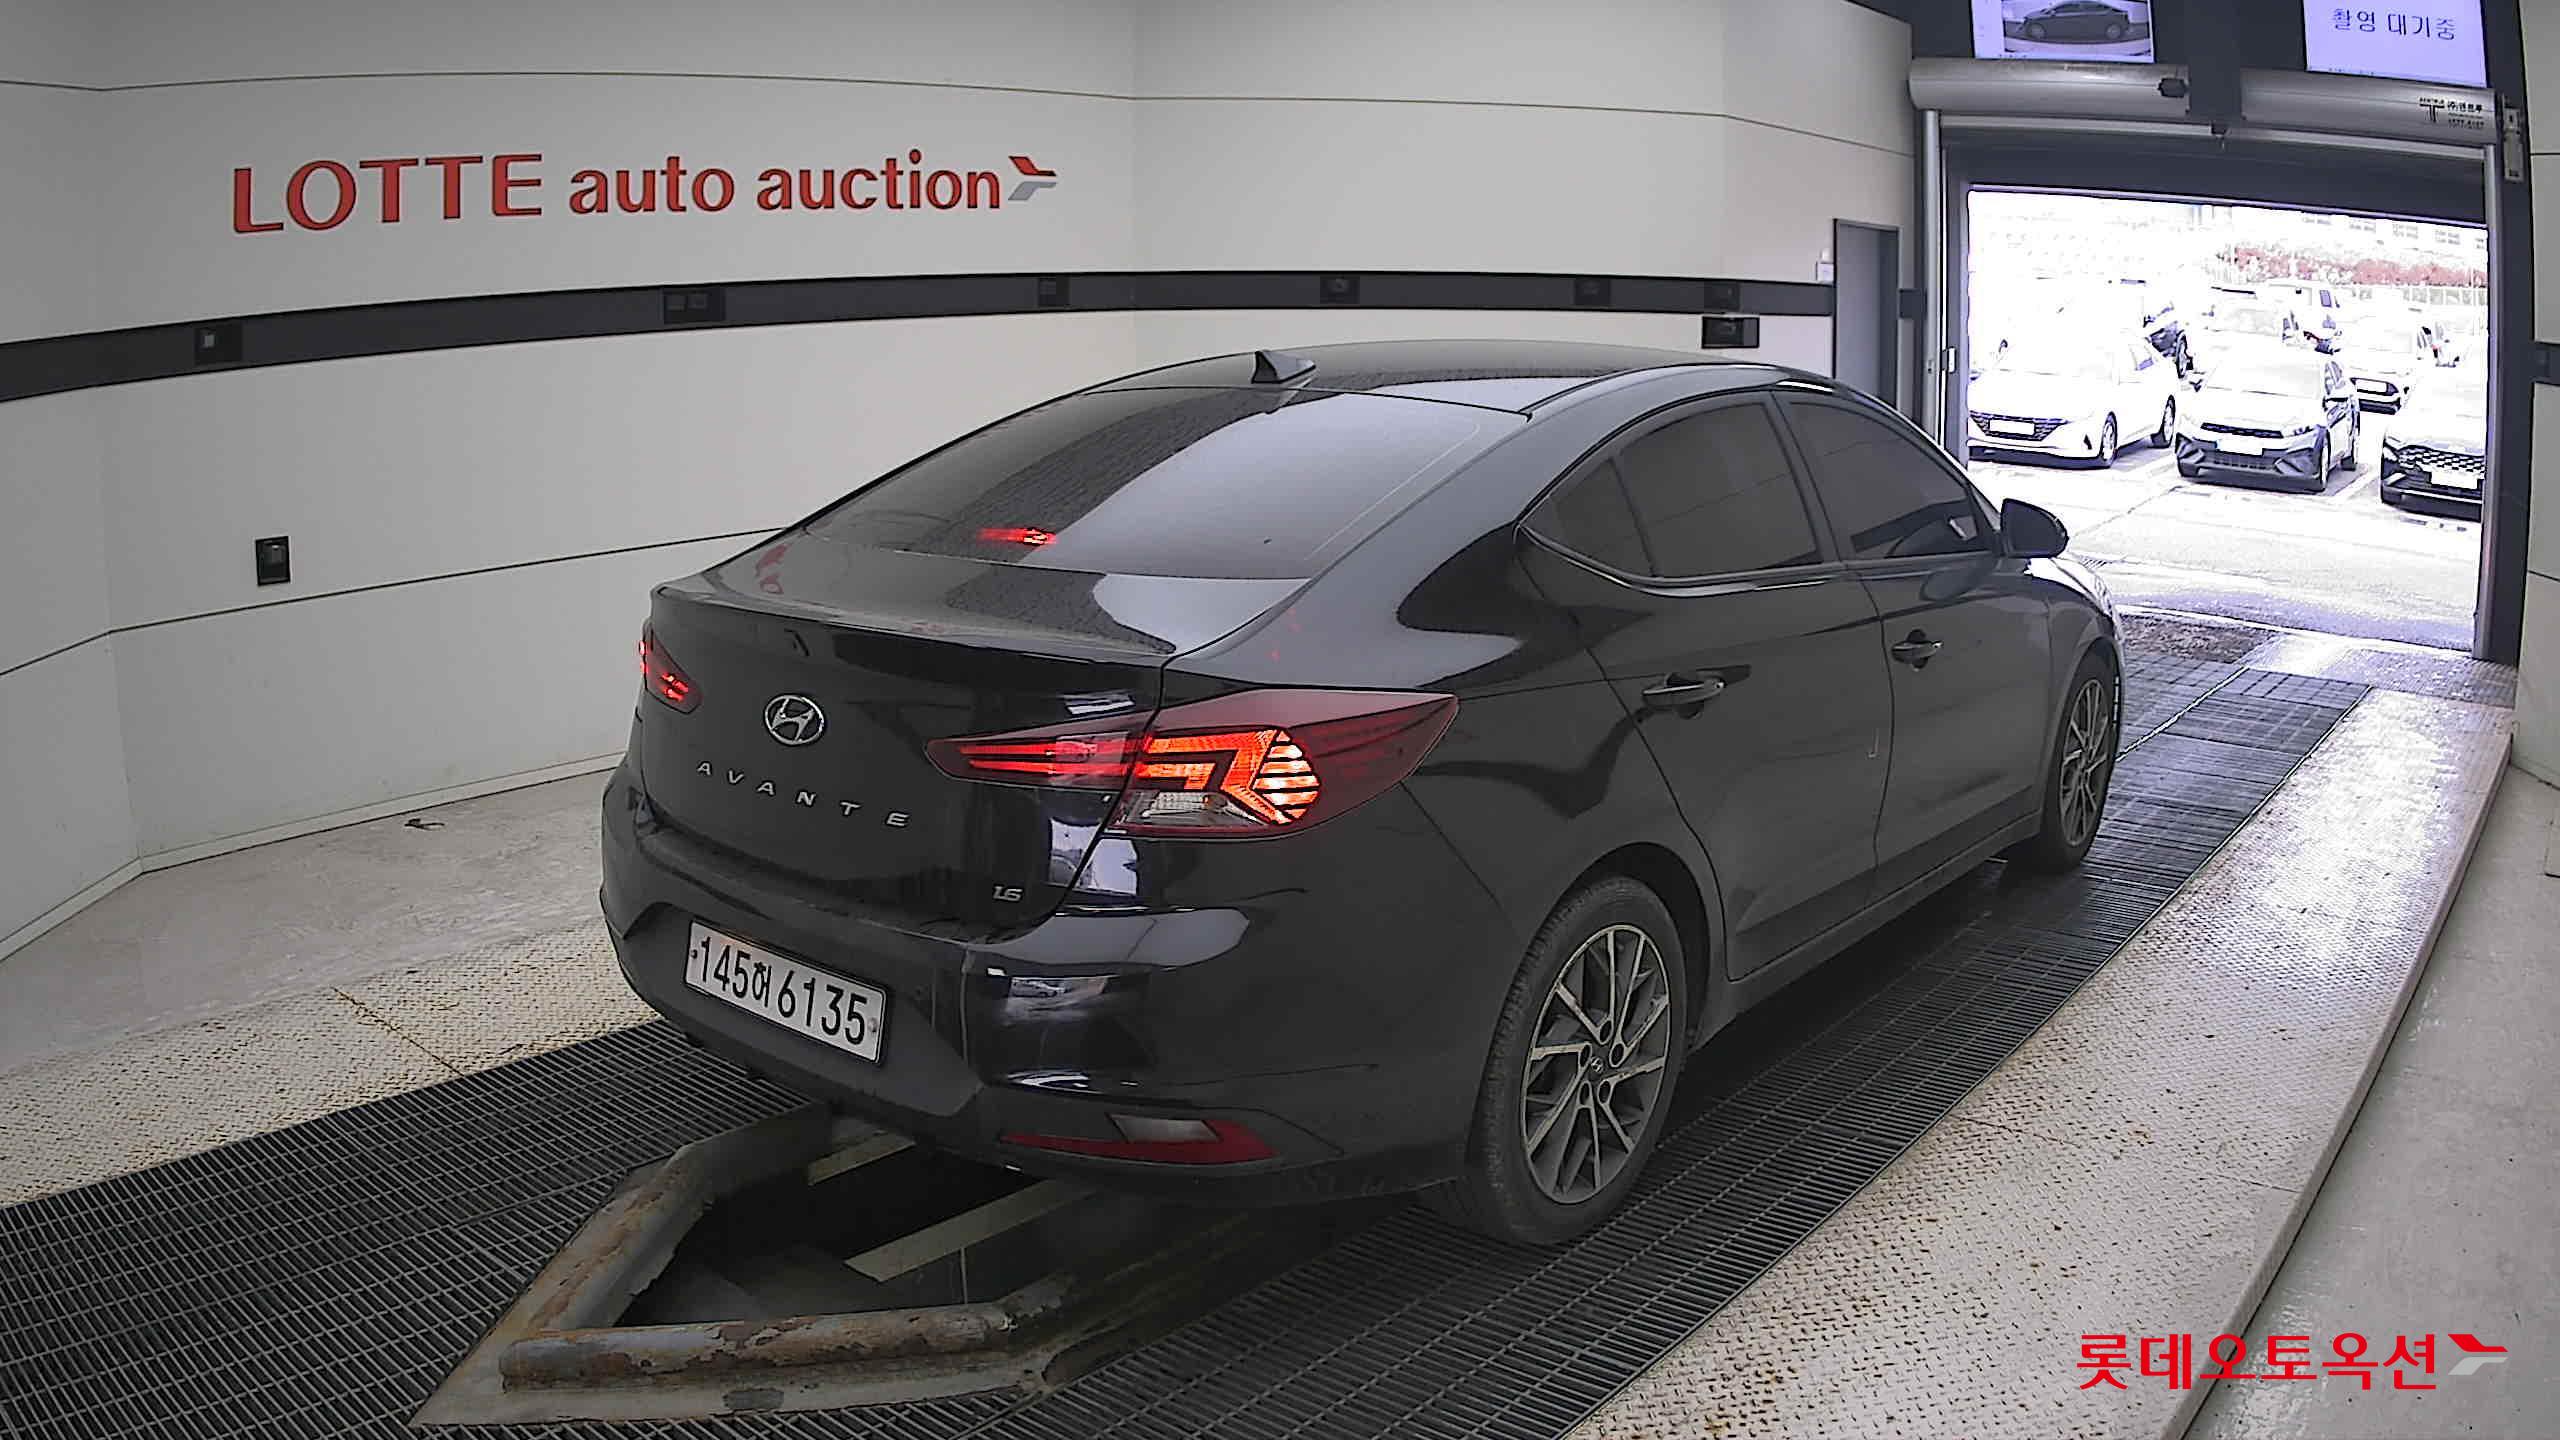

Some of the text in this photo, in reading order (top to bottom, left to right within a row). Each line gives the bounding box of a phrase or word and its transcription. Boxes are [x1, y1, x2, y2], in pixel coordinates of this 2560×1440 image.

[2333, 8, 2456, 41] 촬영 대기중
[233, 149, 1000, 233] LOTTE auto auction
[697, 761, 910, 827] AVANTE
